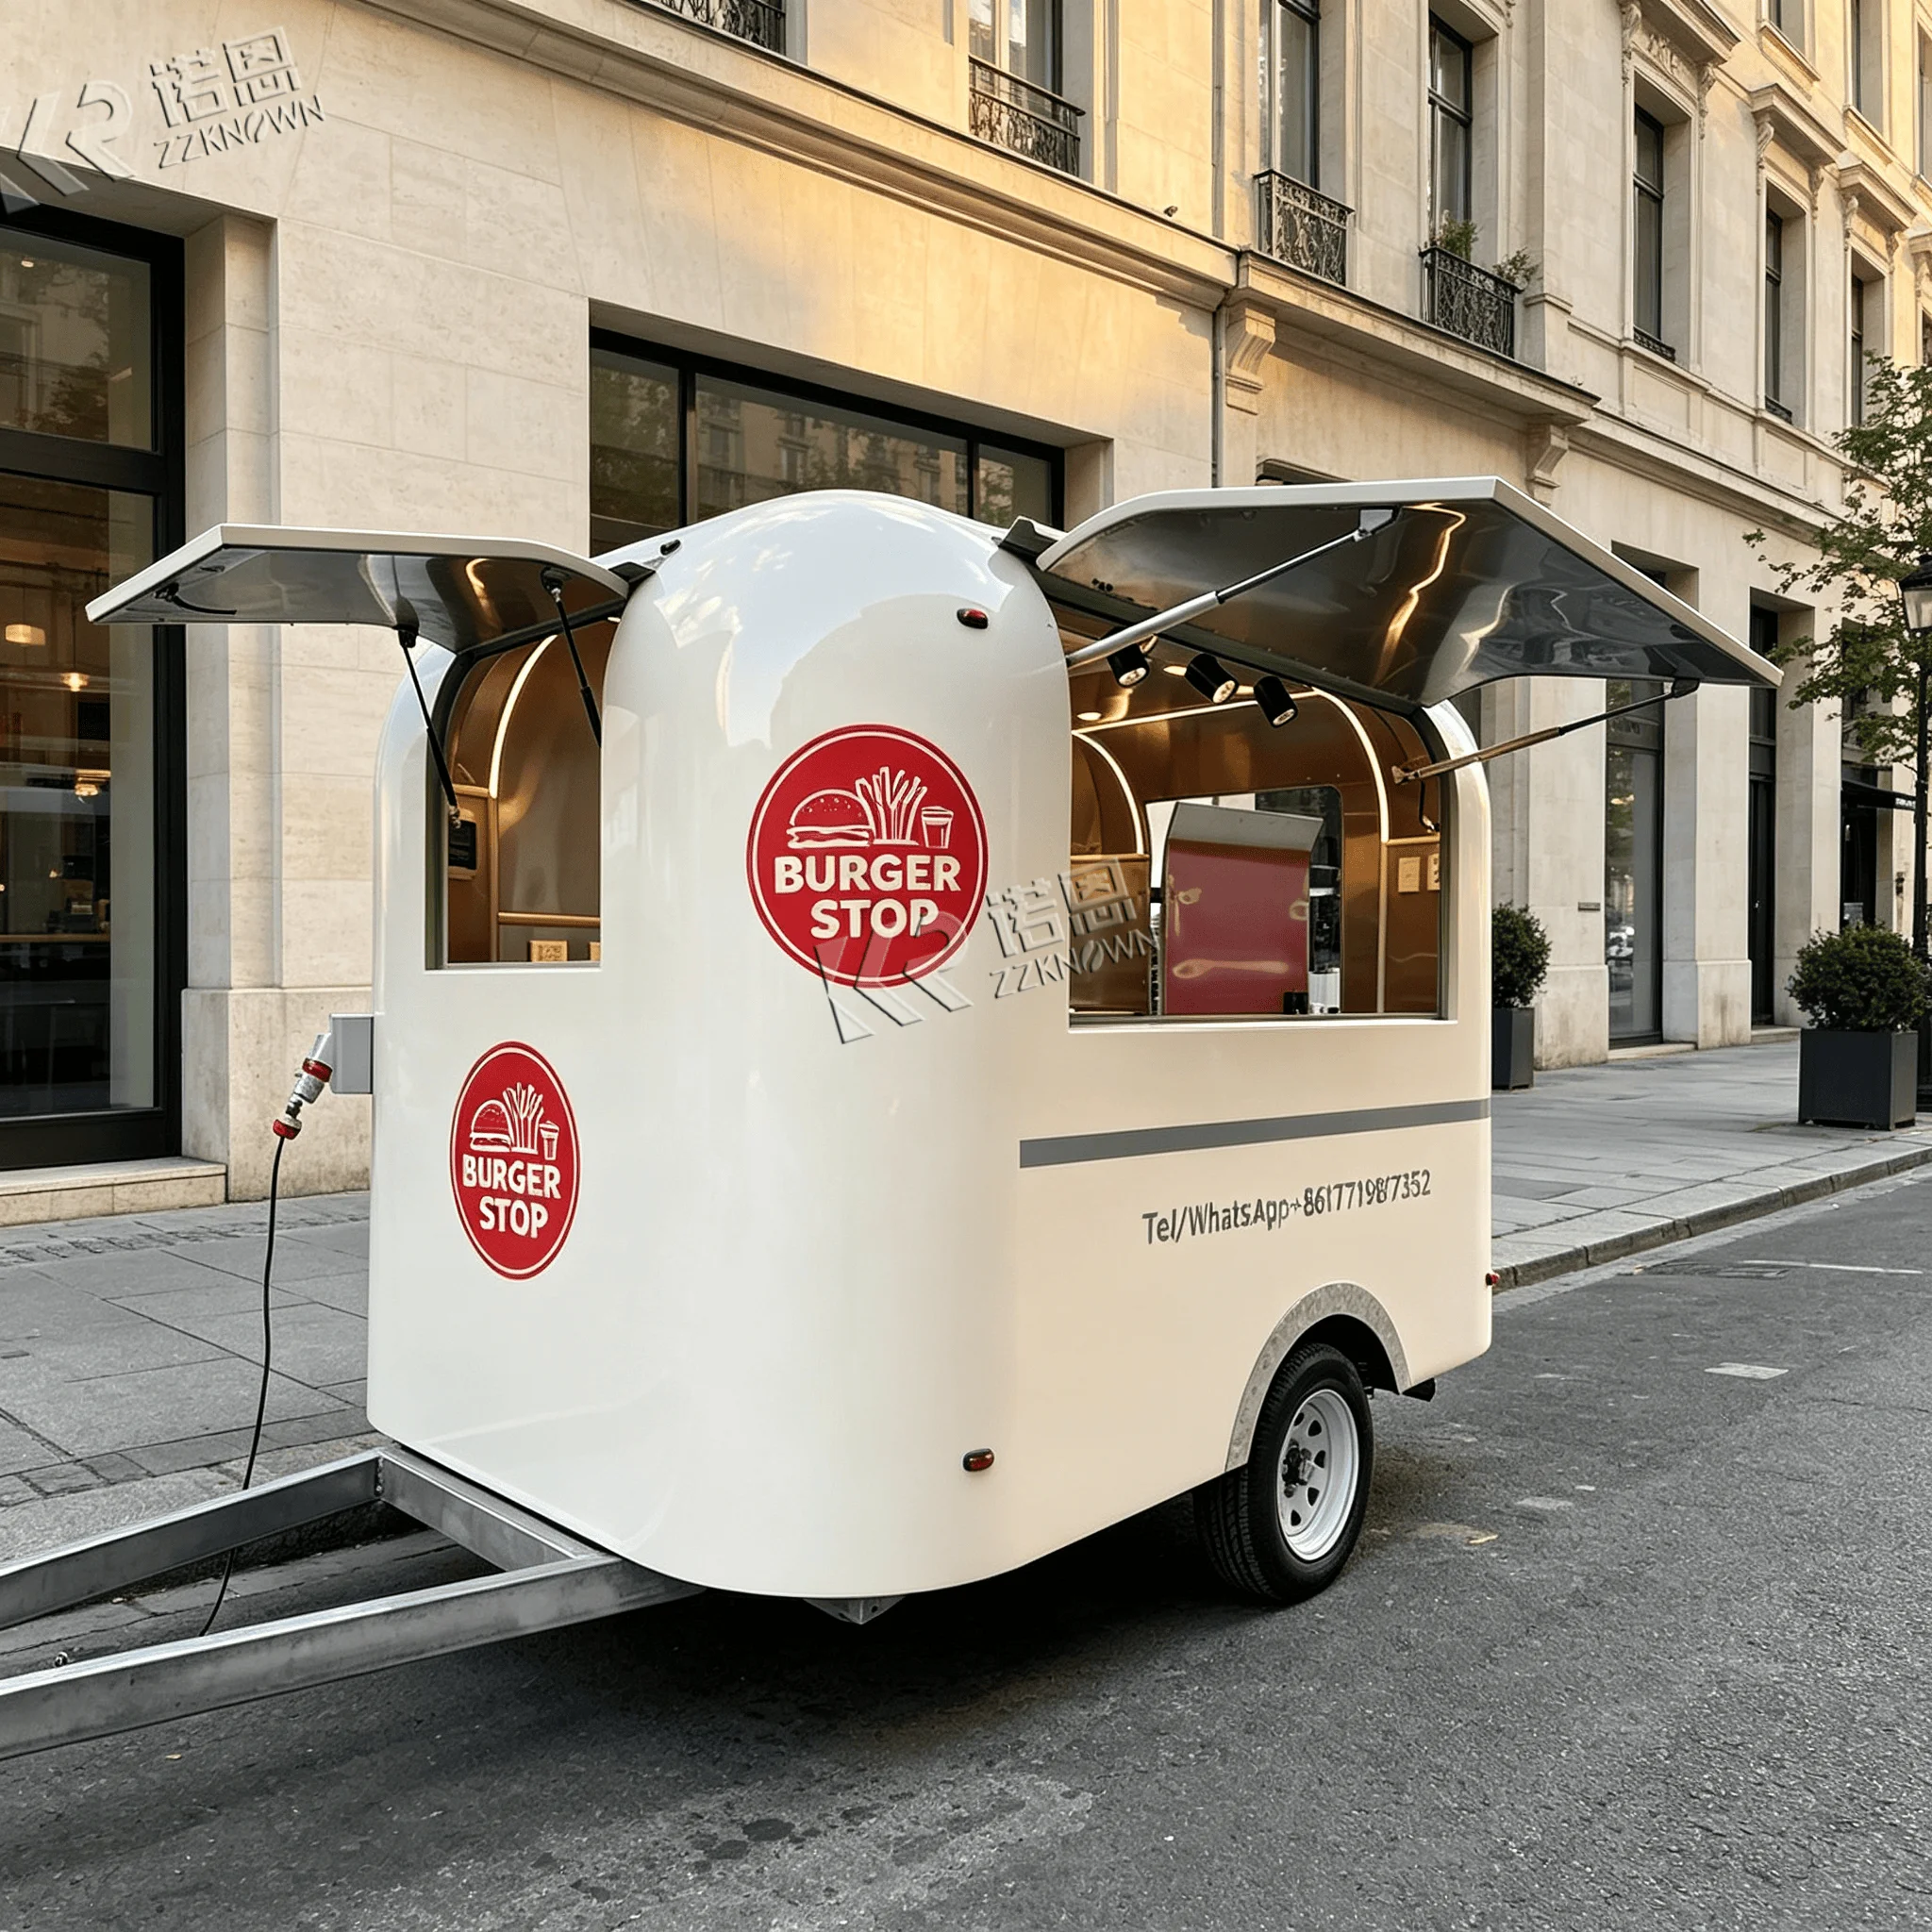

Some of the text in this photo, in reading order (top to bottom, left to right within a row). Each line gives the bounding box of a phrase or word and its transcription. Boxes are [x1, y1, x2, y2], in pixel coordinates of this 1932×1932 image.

[774, 854, 961, 894] BURGER
[809, 898, 940, 940] STOP
[462, 1154, 561, 1199] BURGER
[479, 1196, 548, 1239] STOP
